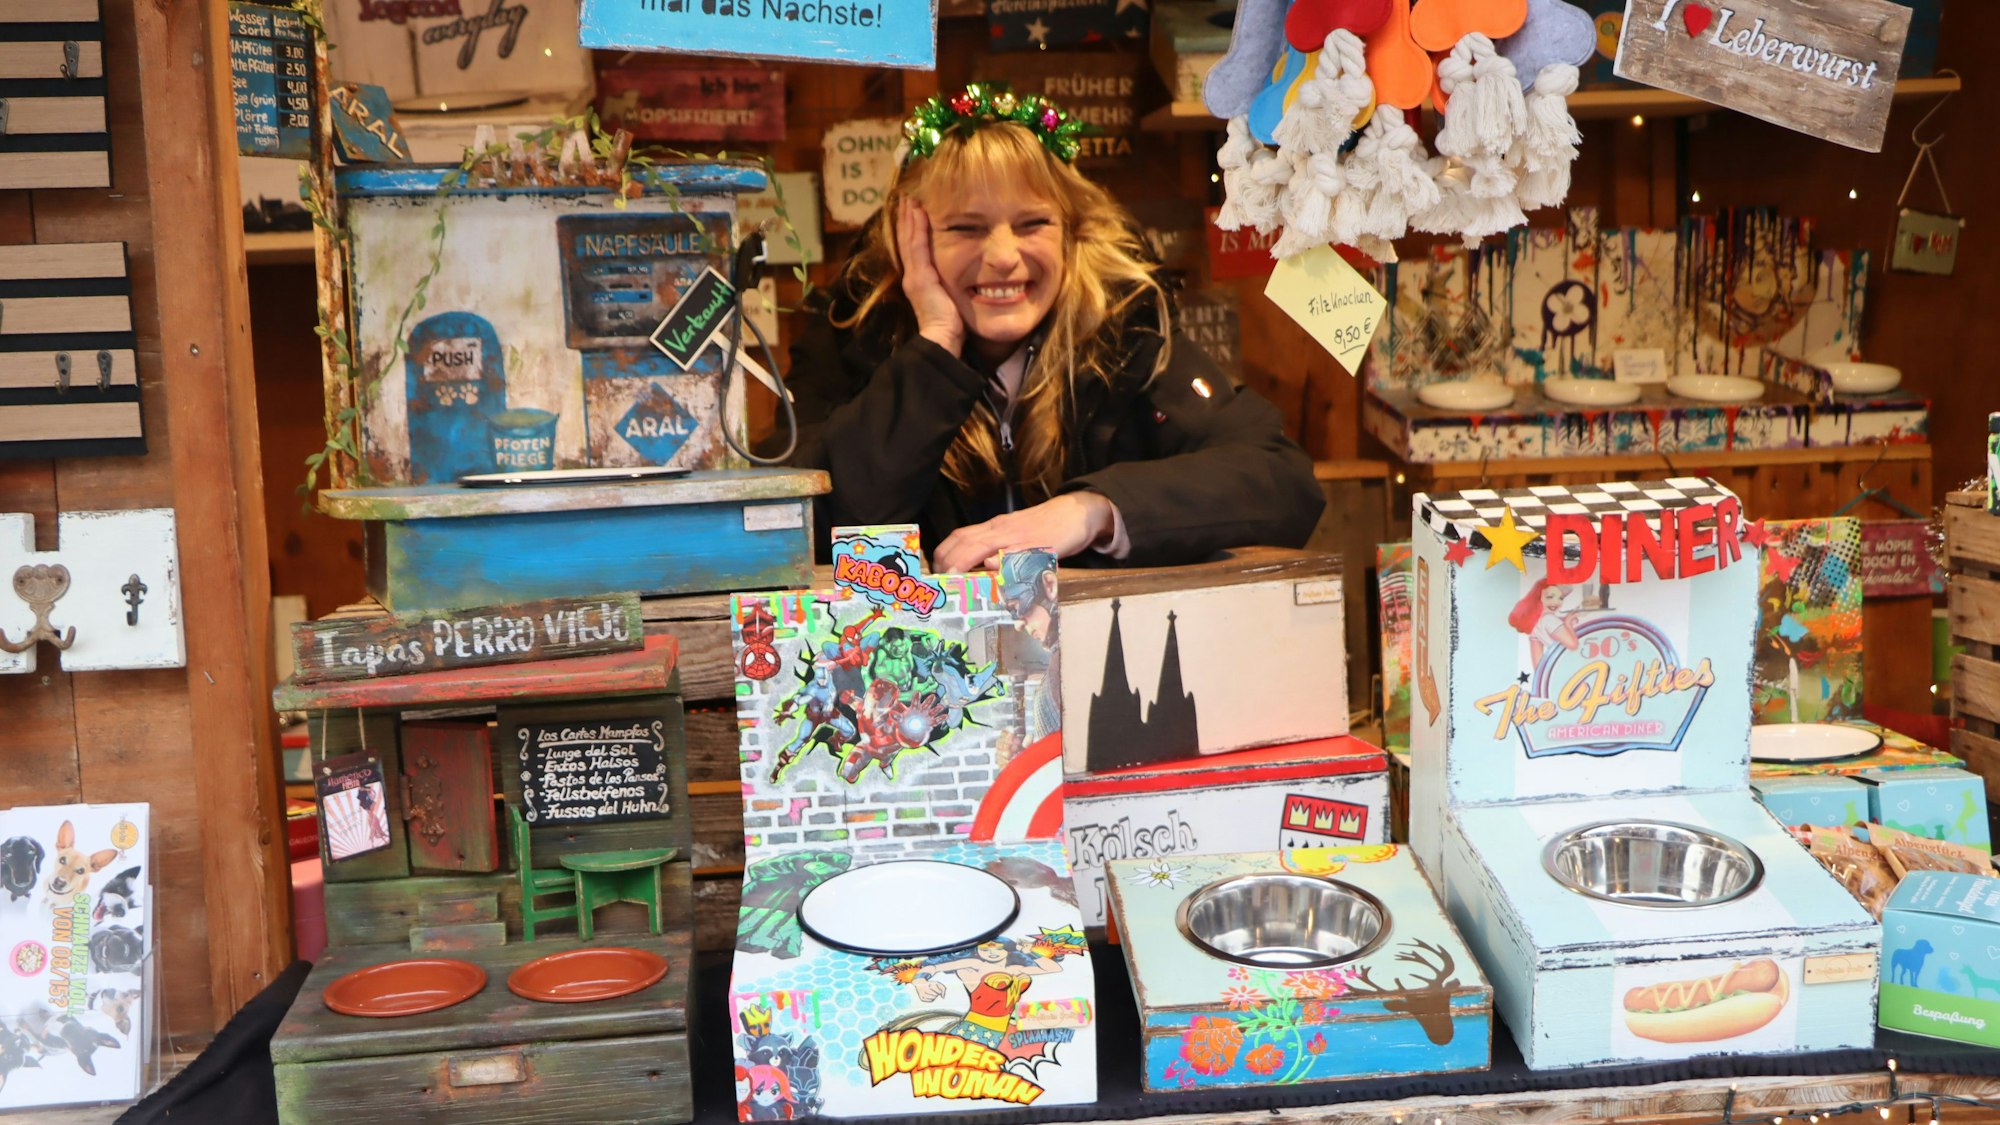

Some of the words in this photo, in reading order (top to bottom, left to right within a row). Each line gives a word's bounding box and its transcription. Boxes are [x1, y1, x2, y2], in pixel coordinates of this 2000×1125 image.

[229, 9, 268, 26] Wasser
[238, 25, 270, 37] Sorte
[1652, 0, 1681, 31] I
[1708, 7, 1878, 90] Leberwurst
[286, 63, 306, 77] 2.50
[1045, 74, 1133, 96] FRÜHER
[251, 92, 276, 108] (grün)
[329, 87, 403, 158] ARAL
[1068, 106, 1133, 125] MEHR
[838, 135, 894, 154] OHN
[1080, 137, 1133, 156] ETTA
[841, 163, 861, 179] IS
[585, 232, 700, 256] NAPFSÄULE
[1219, 232, 1240, 253] IS
[664, 280, 734, 353] Verkauft
[1334, 325, 1361, 350] 8,50
[1363, 317, 1372, 335] €
[432, 351, 474, 367] PUSH
[625, 416, 689, 439] ARAL
[494, 437, 551, 453] PFOTEN
[496, 451, 548, 467] PFLEGE
[1545, 496, 1743, 585] DINER
[836, 555, 938, 613] KABOOM
[1418, 569, 1429, 677] EAT
[315, 631, 425, 675] Tapas
[432, 616, 536, 659] PERRO
[543, 602, 630, 648] VIEJO
[1580, 631, 1638, 660] 50's
[1474, 684, 1558, 740] The
[1558, 657, 1715, 724] Fifties
[537, 729, 558, 742] Los
[599, 724, 650, 740] Mampfos
[1548, 722, 1620, 739] AMERICAN
[1624, 721, 1664, 737] DINER
[589, 756, 639, 771] Halsos
[589, 771, 603, 785] de
[604, 771, 622, 785] los
[598, 801, 618, 816] del
[621, 800, 658, 814] Huhn
[1070, 809, 1199, 871] Kölsch
[51, 907, 74, 943] VON
[71, 892, 91, 975] SCHNAUZE
[48, 945, 71, 1009] 08/15?
[1912, 1003, 1987, 1030] Bespaßung
[865, 1029, 1006, 1086] WONDER
[911, 1066, 1044, 1105] WOMAN
